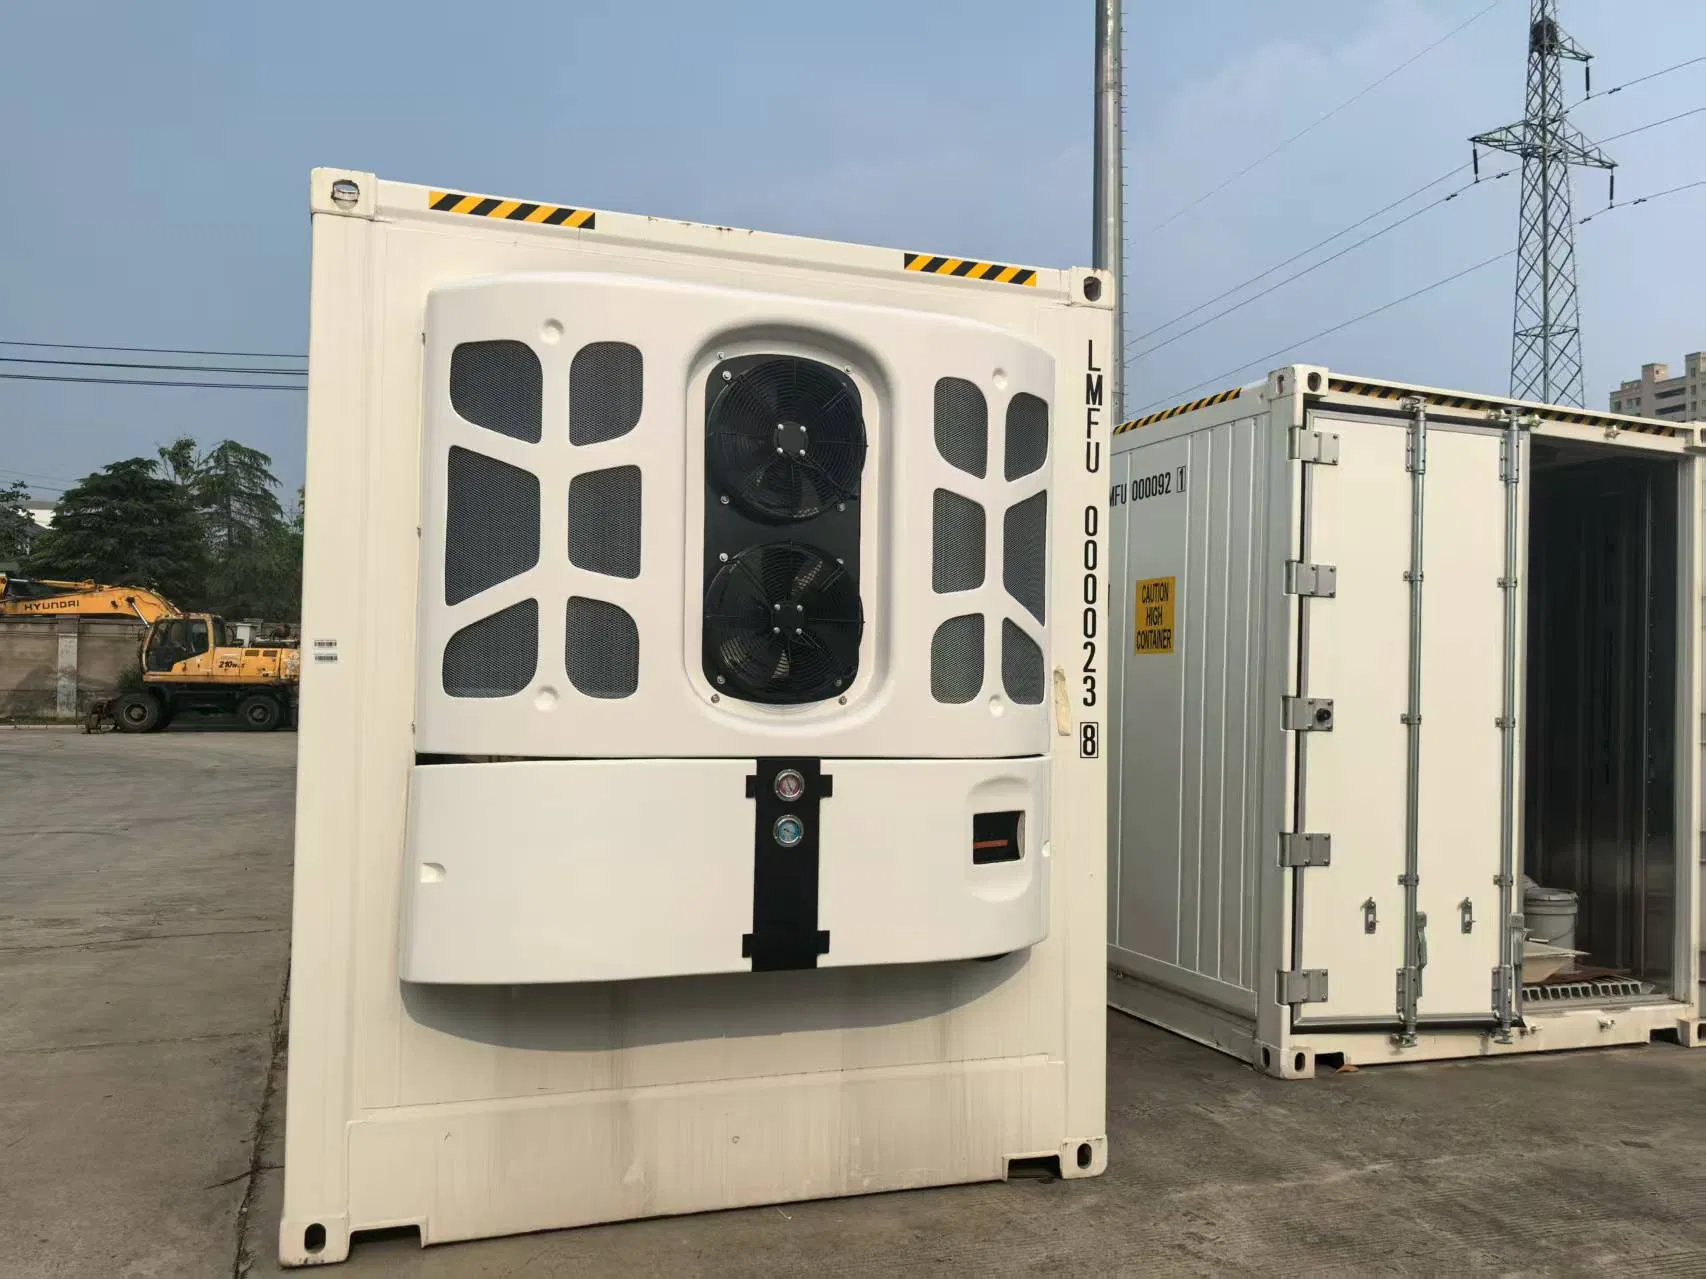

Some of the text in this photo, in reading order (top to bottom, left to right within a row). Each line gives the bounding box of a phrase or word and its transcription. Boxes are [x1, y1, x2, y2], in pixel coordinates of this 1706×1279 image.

[1132, 472, 1171, 501] 000092
[1081, 339, 1103, 757] LMFU 000023 8
[1142, 582, 1169, 604] CAUTION
[24, 600, 80, 610] HYUNDAI
[1146, 606, 1163, 626] HIGH
[1136, 629, 1171, 649] CONTAINER
